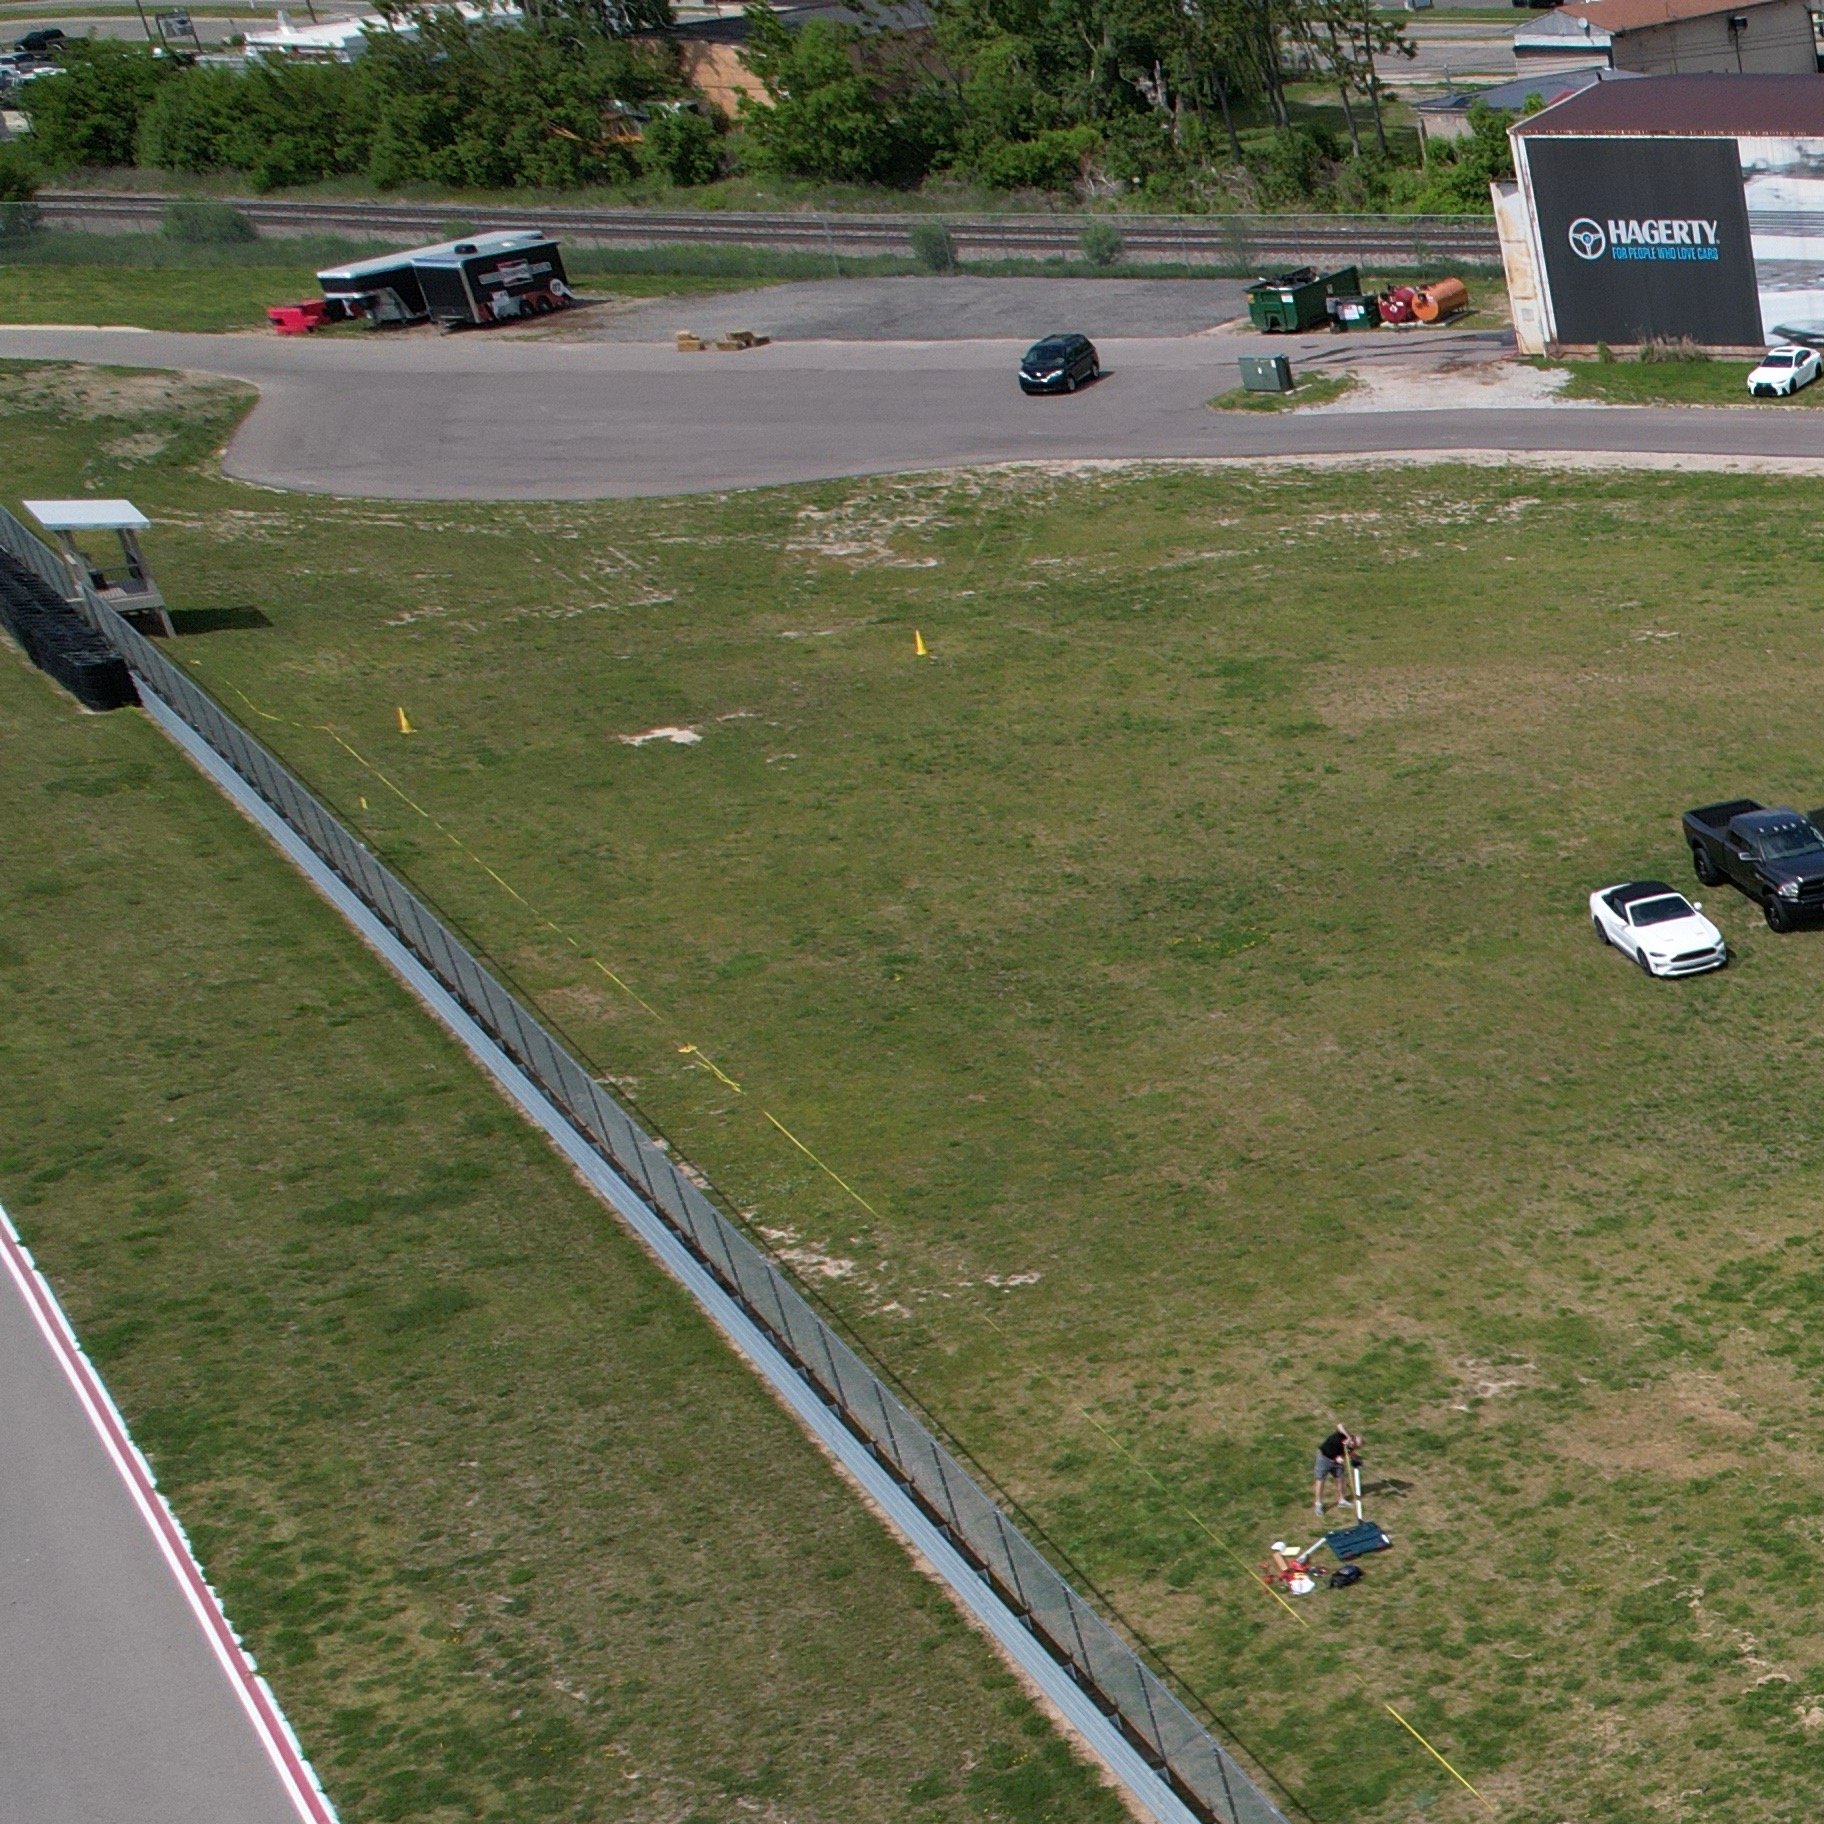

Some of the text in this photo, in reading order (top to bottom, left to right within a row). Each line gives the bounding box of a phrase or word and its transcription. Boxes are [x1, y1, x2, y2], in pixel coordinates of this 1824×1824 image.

[1607, 219, 1718, 245] HAGERTY
[1612, 247, 1719, 261] FOR PEOPLE WHO LOVE CARS
